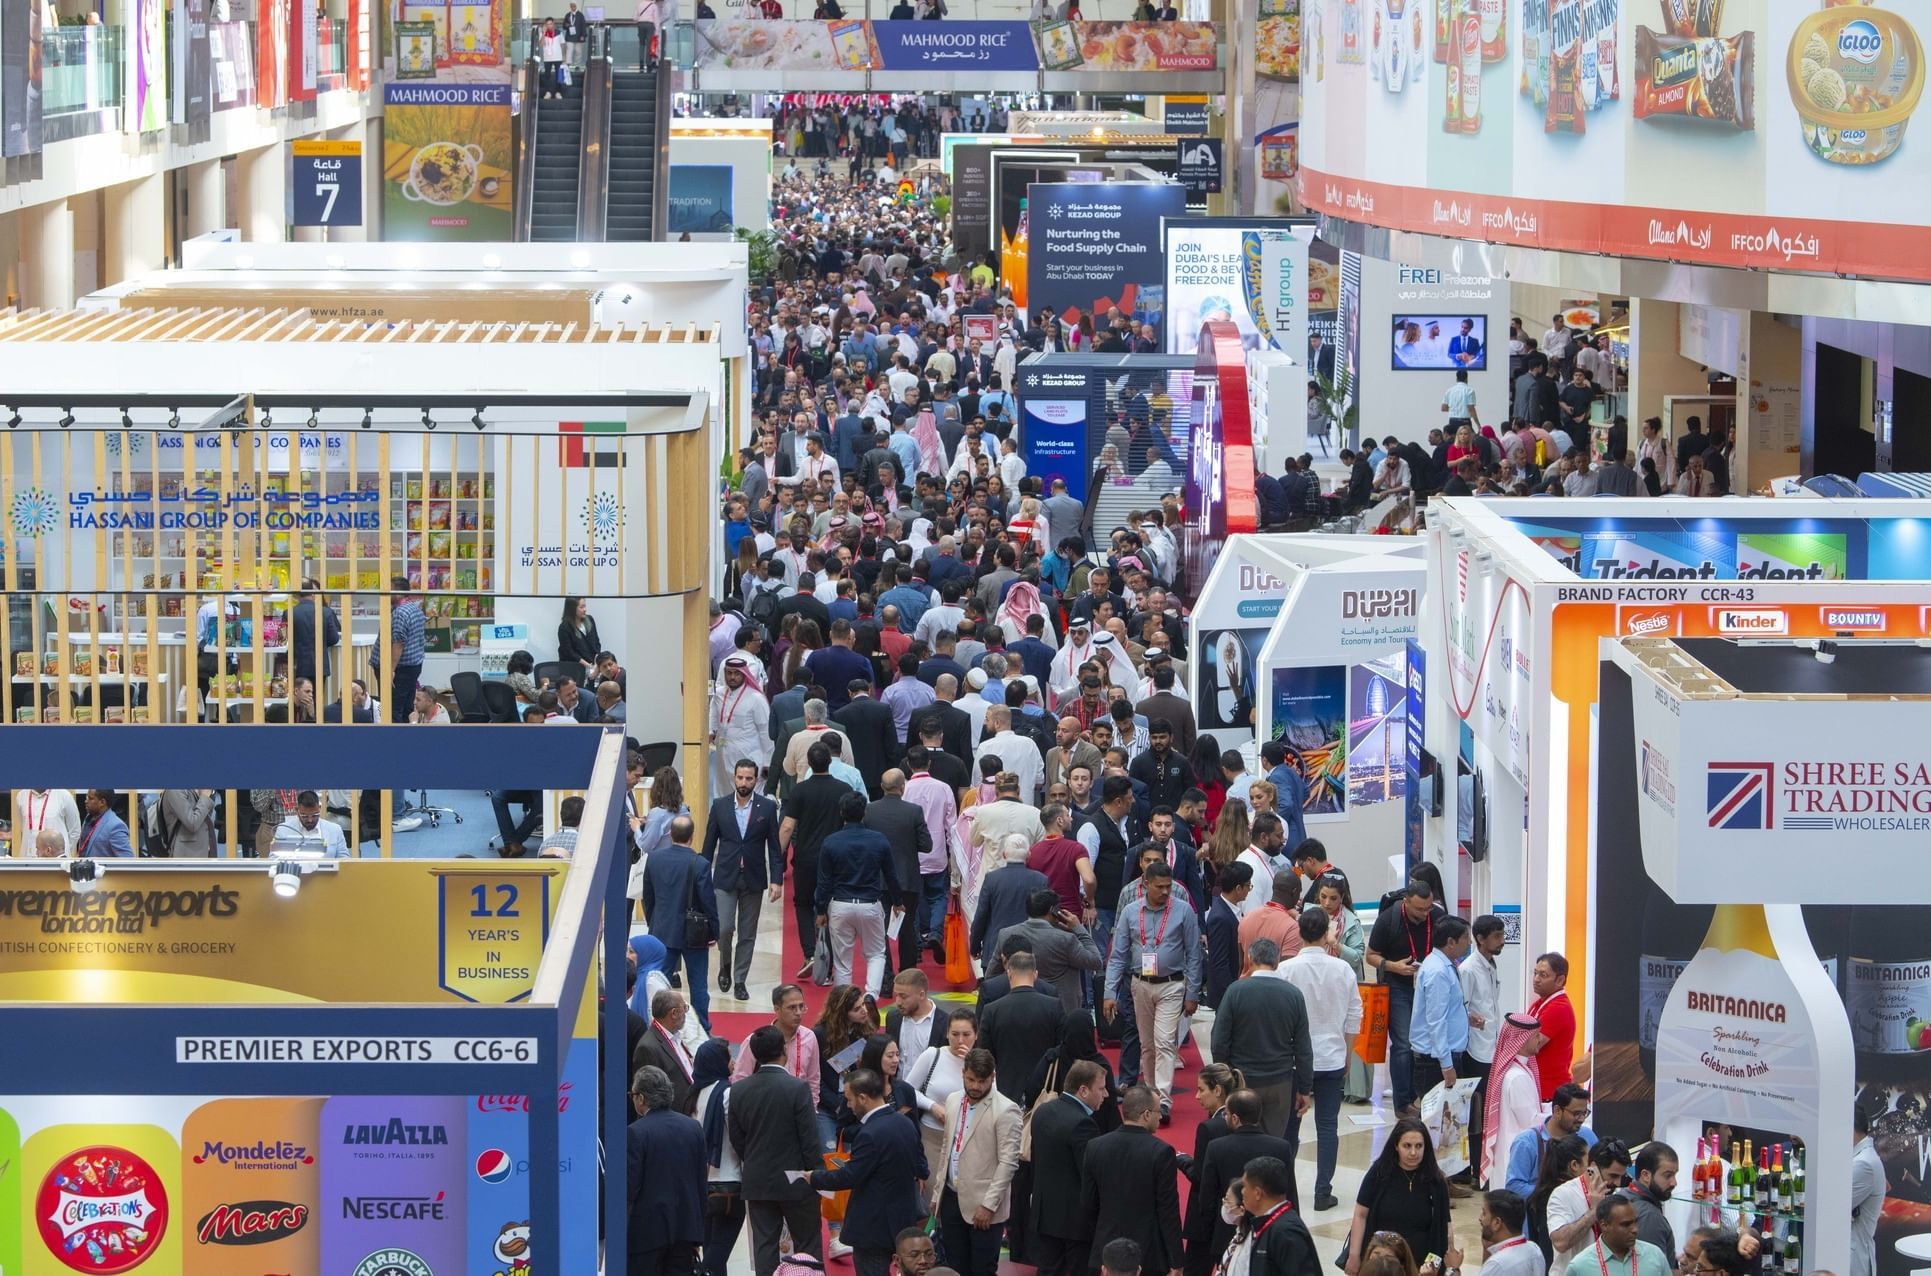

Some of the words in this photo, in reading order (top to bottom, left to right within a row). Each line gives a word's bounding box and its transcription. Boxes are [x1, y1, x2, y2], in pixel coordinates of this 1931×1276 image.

[1479, 1, 1498, 14] PASTE
[1551, 2, 1580, 50] FINNS
[901, 34, 975, 47] MAHMOOD
[979, 34, 1006, 47] RICE
[922, 49, 975, 61] محمود
[978, 50, 990, 60] رز
[1159, 57, 1210, 66] MAHMOOD
[1653, 48, 1697, 84] Quanta
[390, 89, 468, 102] MAHMOOD
[472, 89, 500, 102] RICE
[1463, 85, 1478, 96] PASTE
[1658, 87, 1684, 105] ALMOND
[313, 159, 341, 170] قاعة
[318, 172, 337, 182] Hall
[316, 184, 340, 222] 7
[669, 198, 712, 206] TRADITION
[1482, 213, 1504, 229] IFFCO
[1046, 229, 1100, 241] Nurturing
[1102, 229, 1120, 239] the
[1046, 242, 1074, 252] Food
[1076, 242, 1113, 255] Supply
[1115, 242, 1147, 252] Chain
[1175, 243, 1202, 252] JOIN
[1731, 234, 1764, 252] IFFCO
[1175, 254, 1220, 263] DUBAI'S
[1222, 254, 1243, 263] LEA
[1046, 272, 1061, 280] Abu
[1063, 272, 1085, 280] Dhabi
[1085, 272, 1114, 280] TODAY
[1175, 265, 1208, 274] FOOD
[1210, 265, 1218, 274] &
[1221, 265, 1243, 274] BEV
[1175, 275, 1235, 285] FREEZONE
[310, 307, 385, 317] www.hfza.ae
[1308, 320, 1338, 329] HEIKH
[1308, 330, 1337, 340] ASHID
[159, 482, 257, 508] شركات
[263, 486, 379, 508] مجموعة
[69, 512, 155, 529] HASSANI
[160, 512, 228, 530] GROUP
[233, 512, 259, 529] OF
[265, 512, 380, 529] COMPANIES
[609, 557, 618, 567] O
[1558, 588, 1613, 601] BRAND
[1617, 588, 1687, 601] FACTORY
[1700, 588, 1755, 601] CCR-43
[1242, 605, 1260, 613] START
[1828, 612, 1881, 626] BOUNTY
[1341, 637, 1372, 646] Economy
[1373, 636, 1387, 644] and
[1784, 761, 1886, 786] SHREE
[1894, 761, 1931, 786] SA
[1783, 789, 1931, 813] TRADING
[114, 884, 240, 927] exports
[470, 883, 520, 917] 12
[41, 911, 113, 934] london
[115, 911, 145, 934] ltd
[468, 929, 520, 941] YEAR'S
[0, 941, 34, 954] ITISH
[38, 941, 154, 954] CONFECTIONERY
[157, 942, 166, 954] &
[170, 941, 236, 954] GROCERY
[486, 951, 501, 962] IN
[458, 967, 529, 979] BUSINESS
[1855, 964, 1931, 981] BRITANNICA
[1687, 990, 1786, 1024] BRITANNICA
[1712, 1026, 1761, 1046] Sparkling
[184, 1040, 304, 1060] PREMIER
[312, 1040, 432, 1061] EXPORTS
[454, 1040, 529, 1061] CC6-6
[1713, 1045, 1726, 1053] Non
[1727, 1047, 1758, 1058] Alcoholic
[1700, 1051, 1745, 1079] Celebration
[1746, 1060, 1770, 1078] Drink
[343, 1117, 448, 1145] LAVAZZA
[234, 1161, 297, 1170] International
[516, 1157, 571, 1176] psi
[343, 1191, 445, 1220] NESCAFÉ
[198, 1203, 309, 1243] Mars
[357, 1250, 430, 1276] TARBUCK
